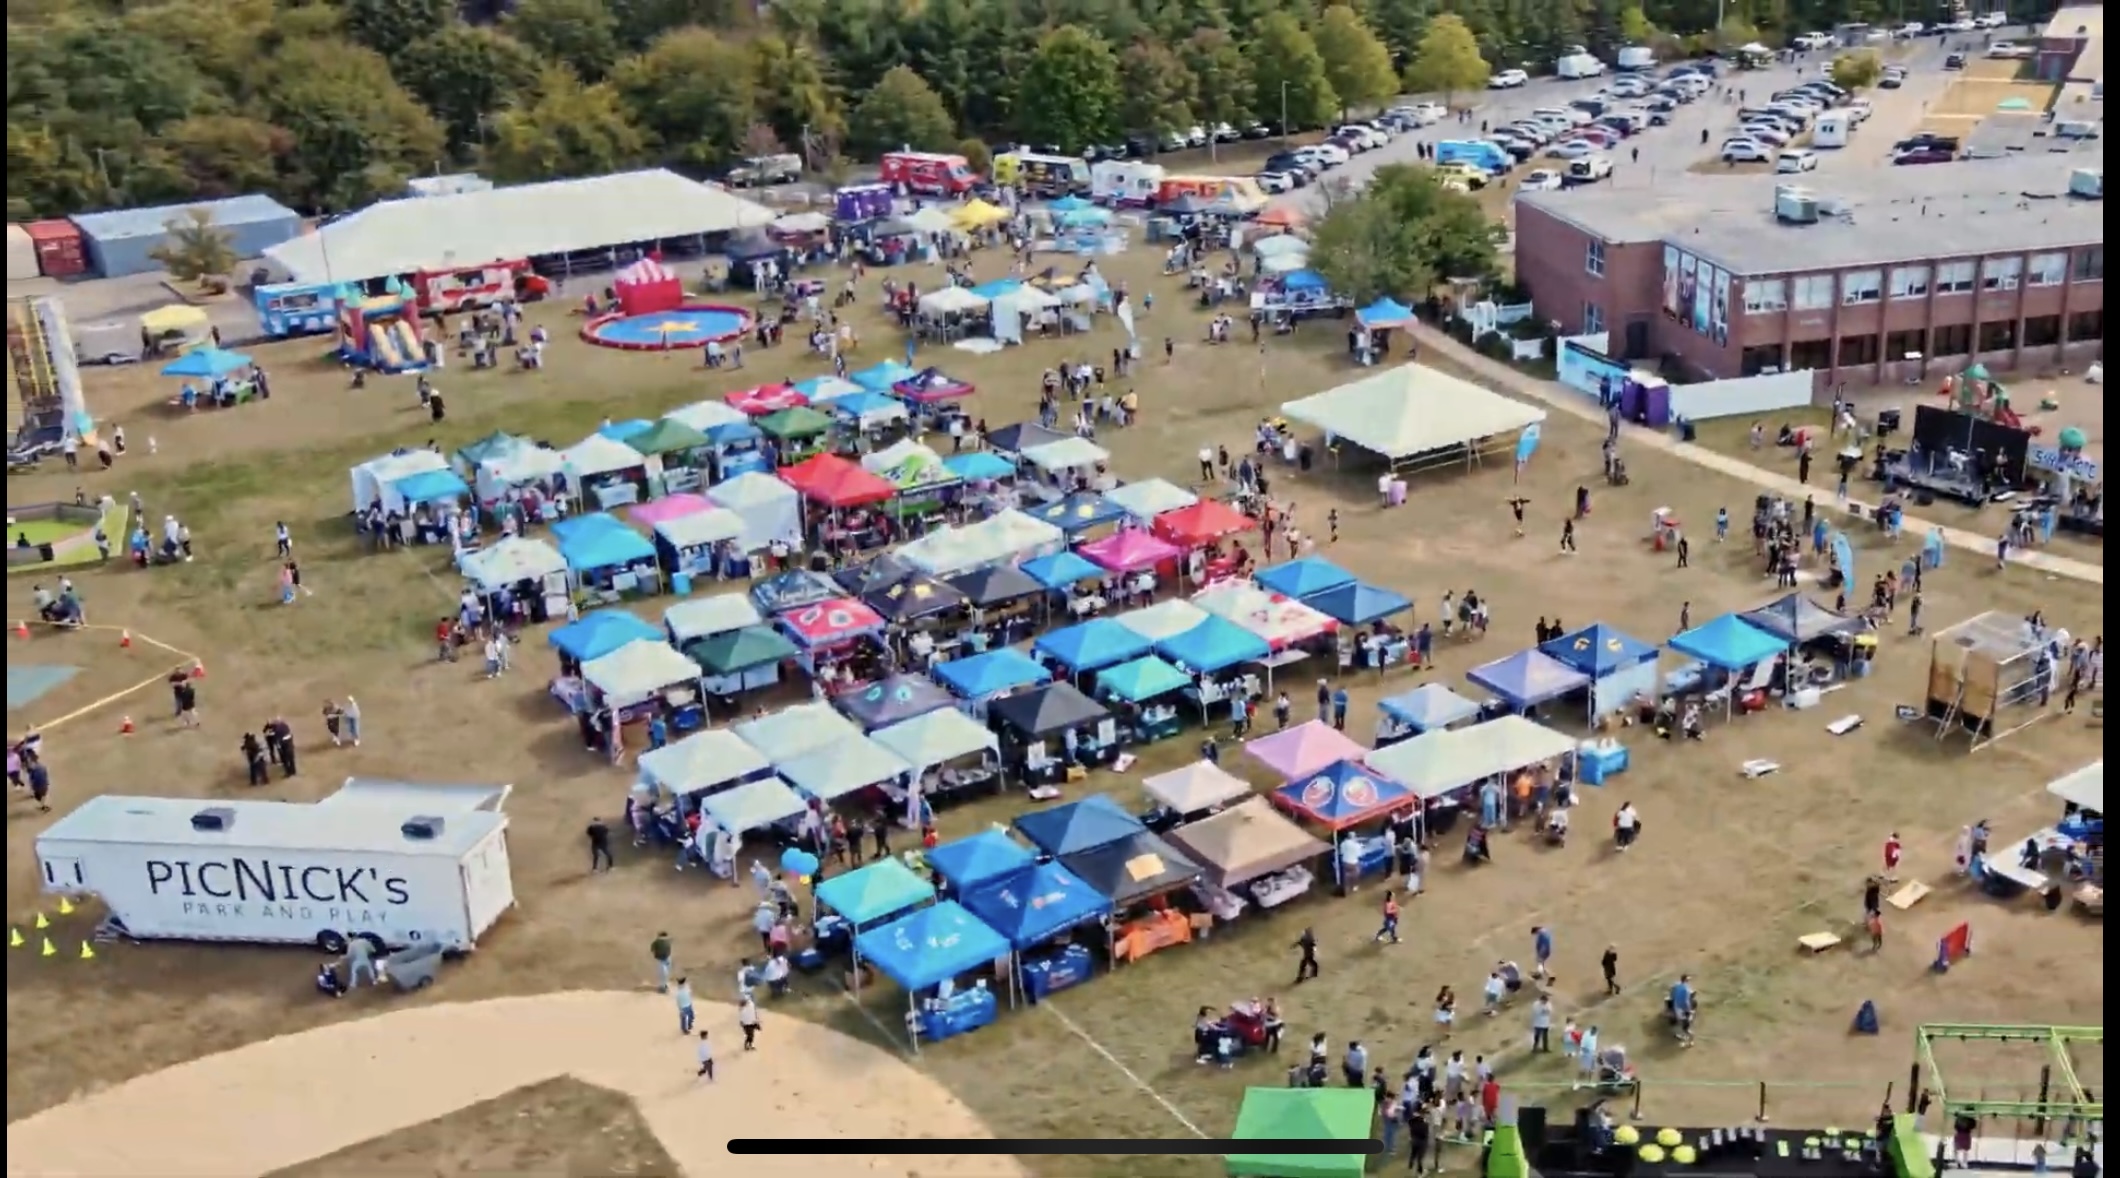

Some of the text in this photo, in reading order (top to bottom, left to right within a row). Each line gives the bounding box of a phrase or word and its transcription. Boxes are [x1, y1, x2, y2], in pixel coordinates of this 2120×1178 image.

[183, 901, 388, 924] PARK AND PLAY
